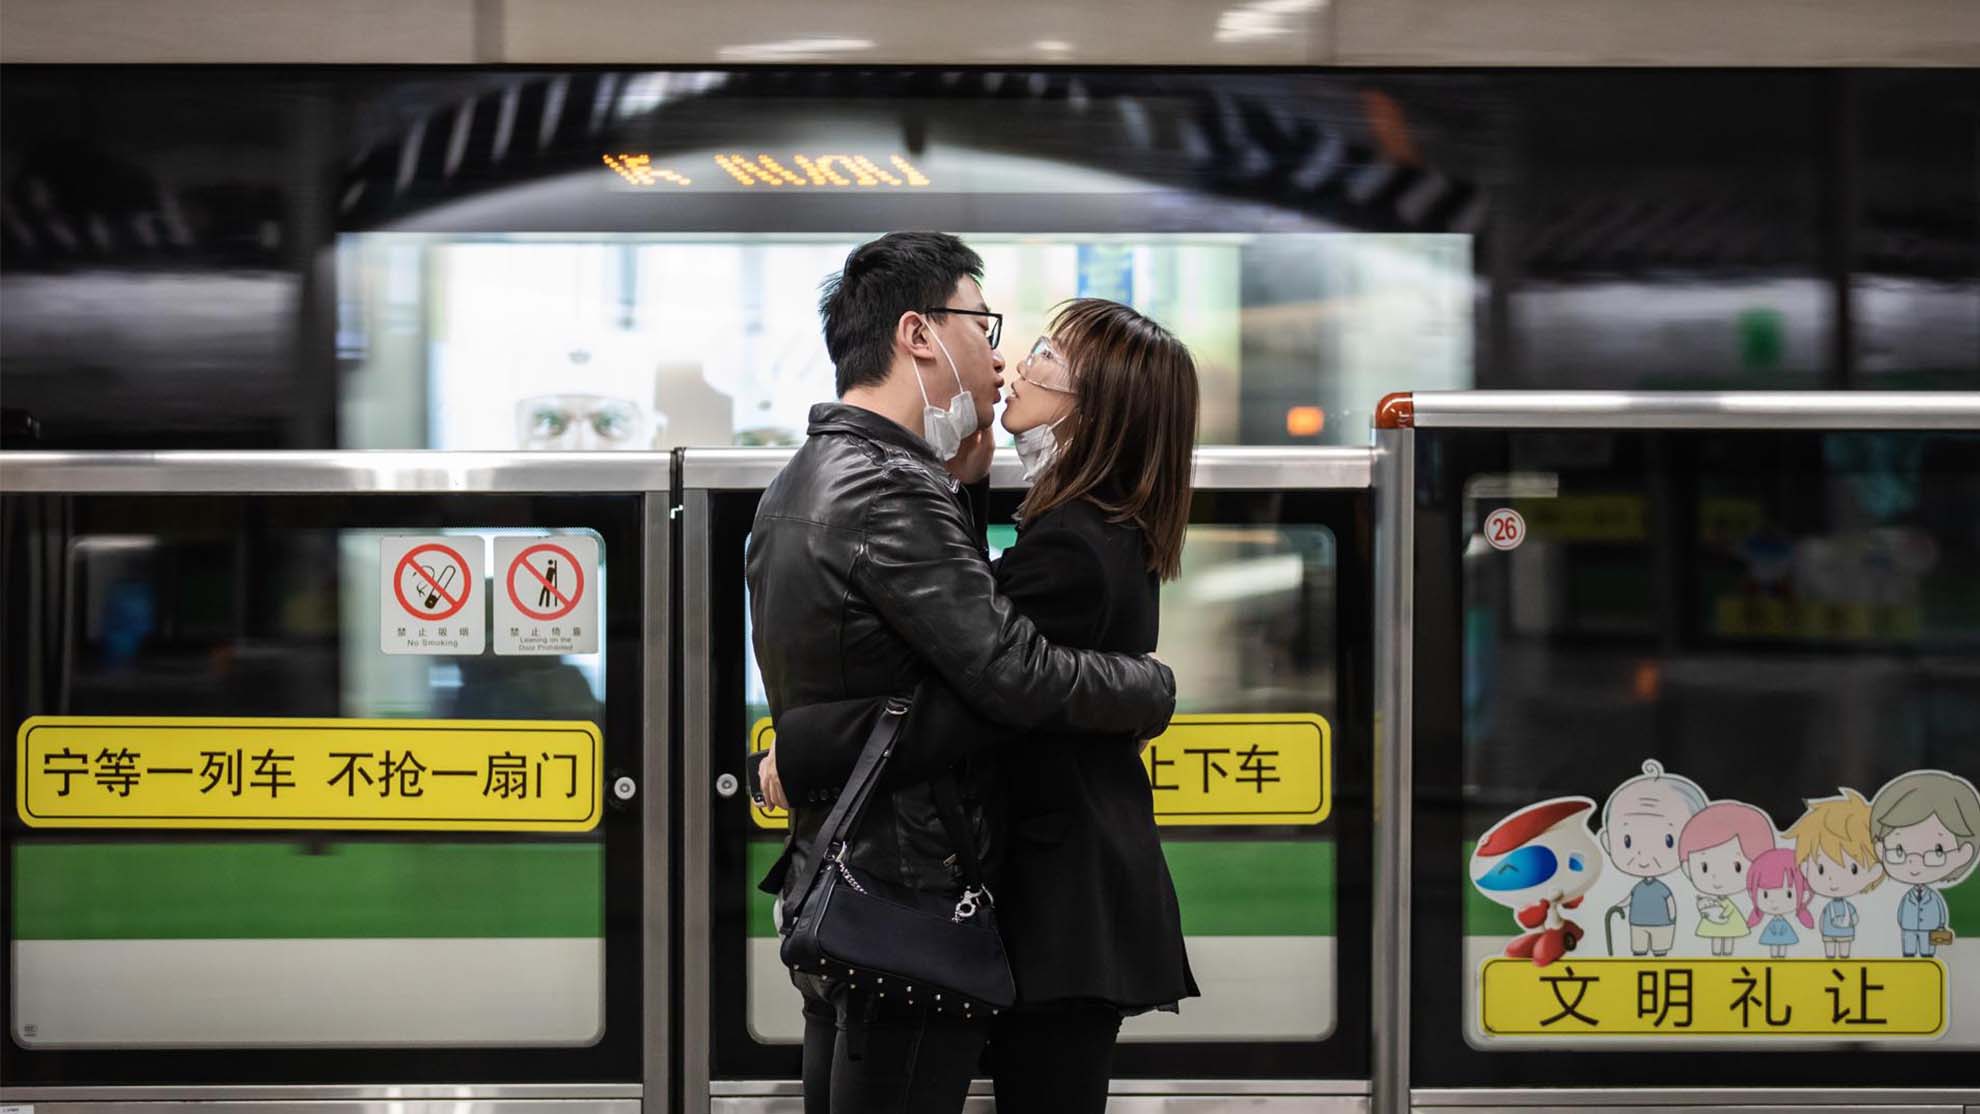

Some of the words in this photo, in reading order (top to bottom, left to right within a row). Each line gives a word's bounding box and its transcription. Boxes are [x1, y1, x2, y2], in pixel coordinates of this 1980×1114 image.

[1493, 517, 1517, 540] 26
[407, 639, 419, 647] No
[422, 639, 459, 648] Smoking
[43, 747, 296, 798] 宁等一列车
[327, 750, 578, 800] 不抢一扇门
[1539, 962, 1887, 1028] 文明礼让
